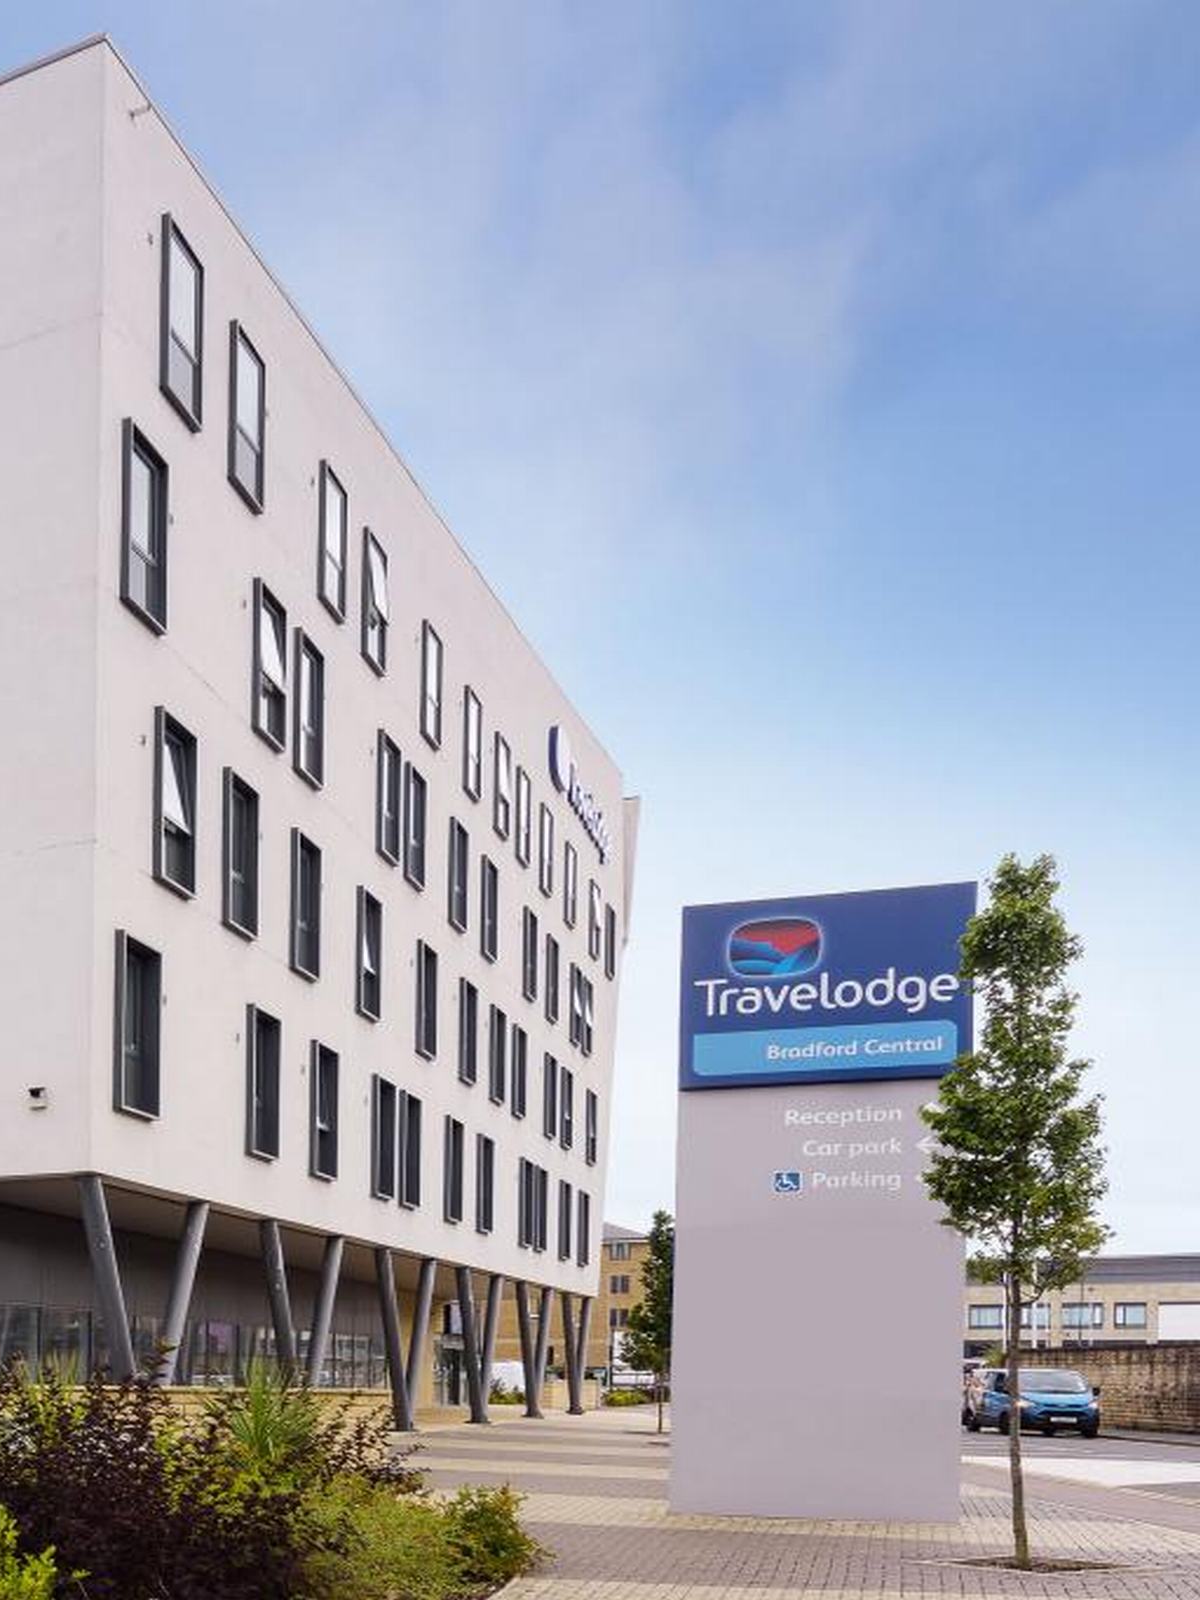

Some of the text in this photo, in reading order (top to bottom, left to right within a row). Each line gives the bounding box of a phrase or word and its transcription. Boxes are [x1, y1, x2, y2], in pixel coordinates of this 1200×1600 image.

[693, 967, 960, 1017] Travelodge
[767, 1036, 943, 1060] Bradford Central
[784, 1107, 902, 1127] Reception
[802, 1138, 902, 1158] Car park
[811, 1171, 902, 1191] Parking
